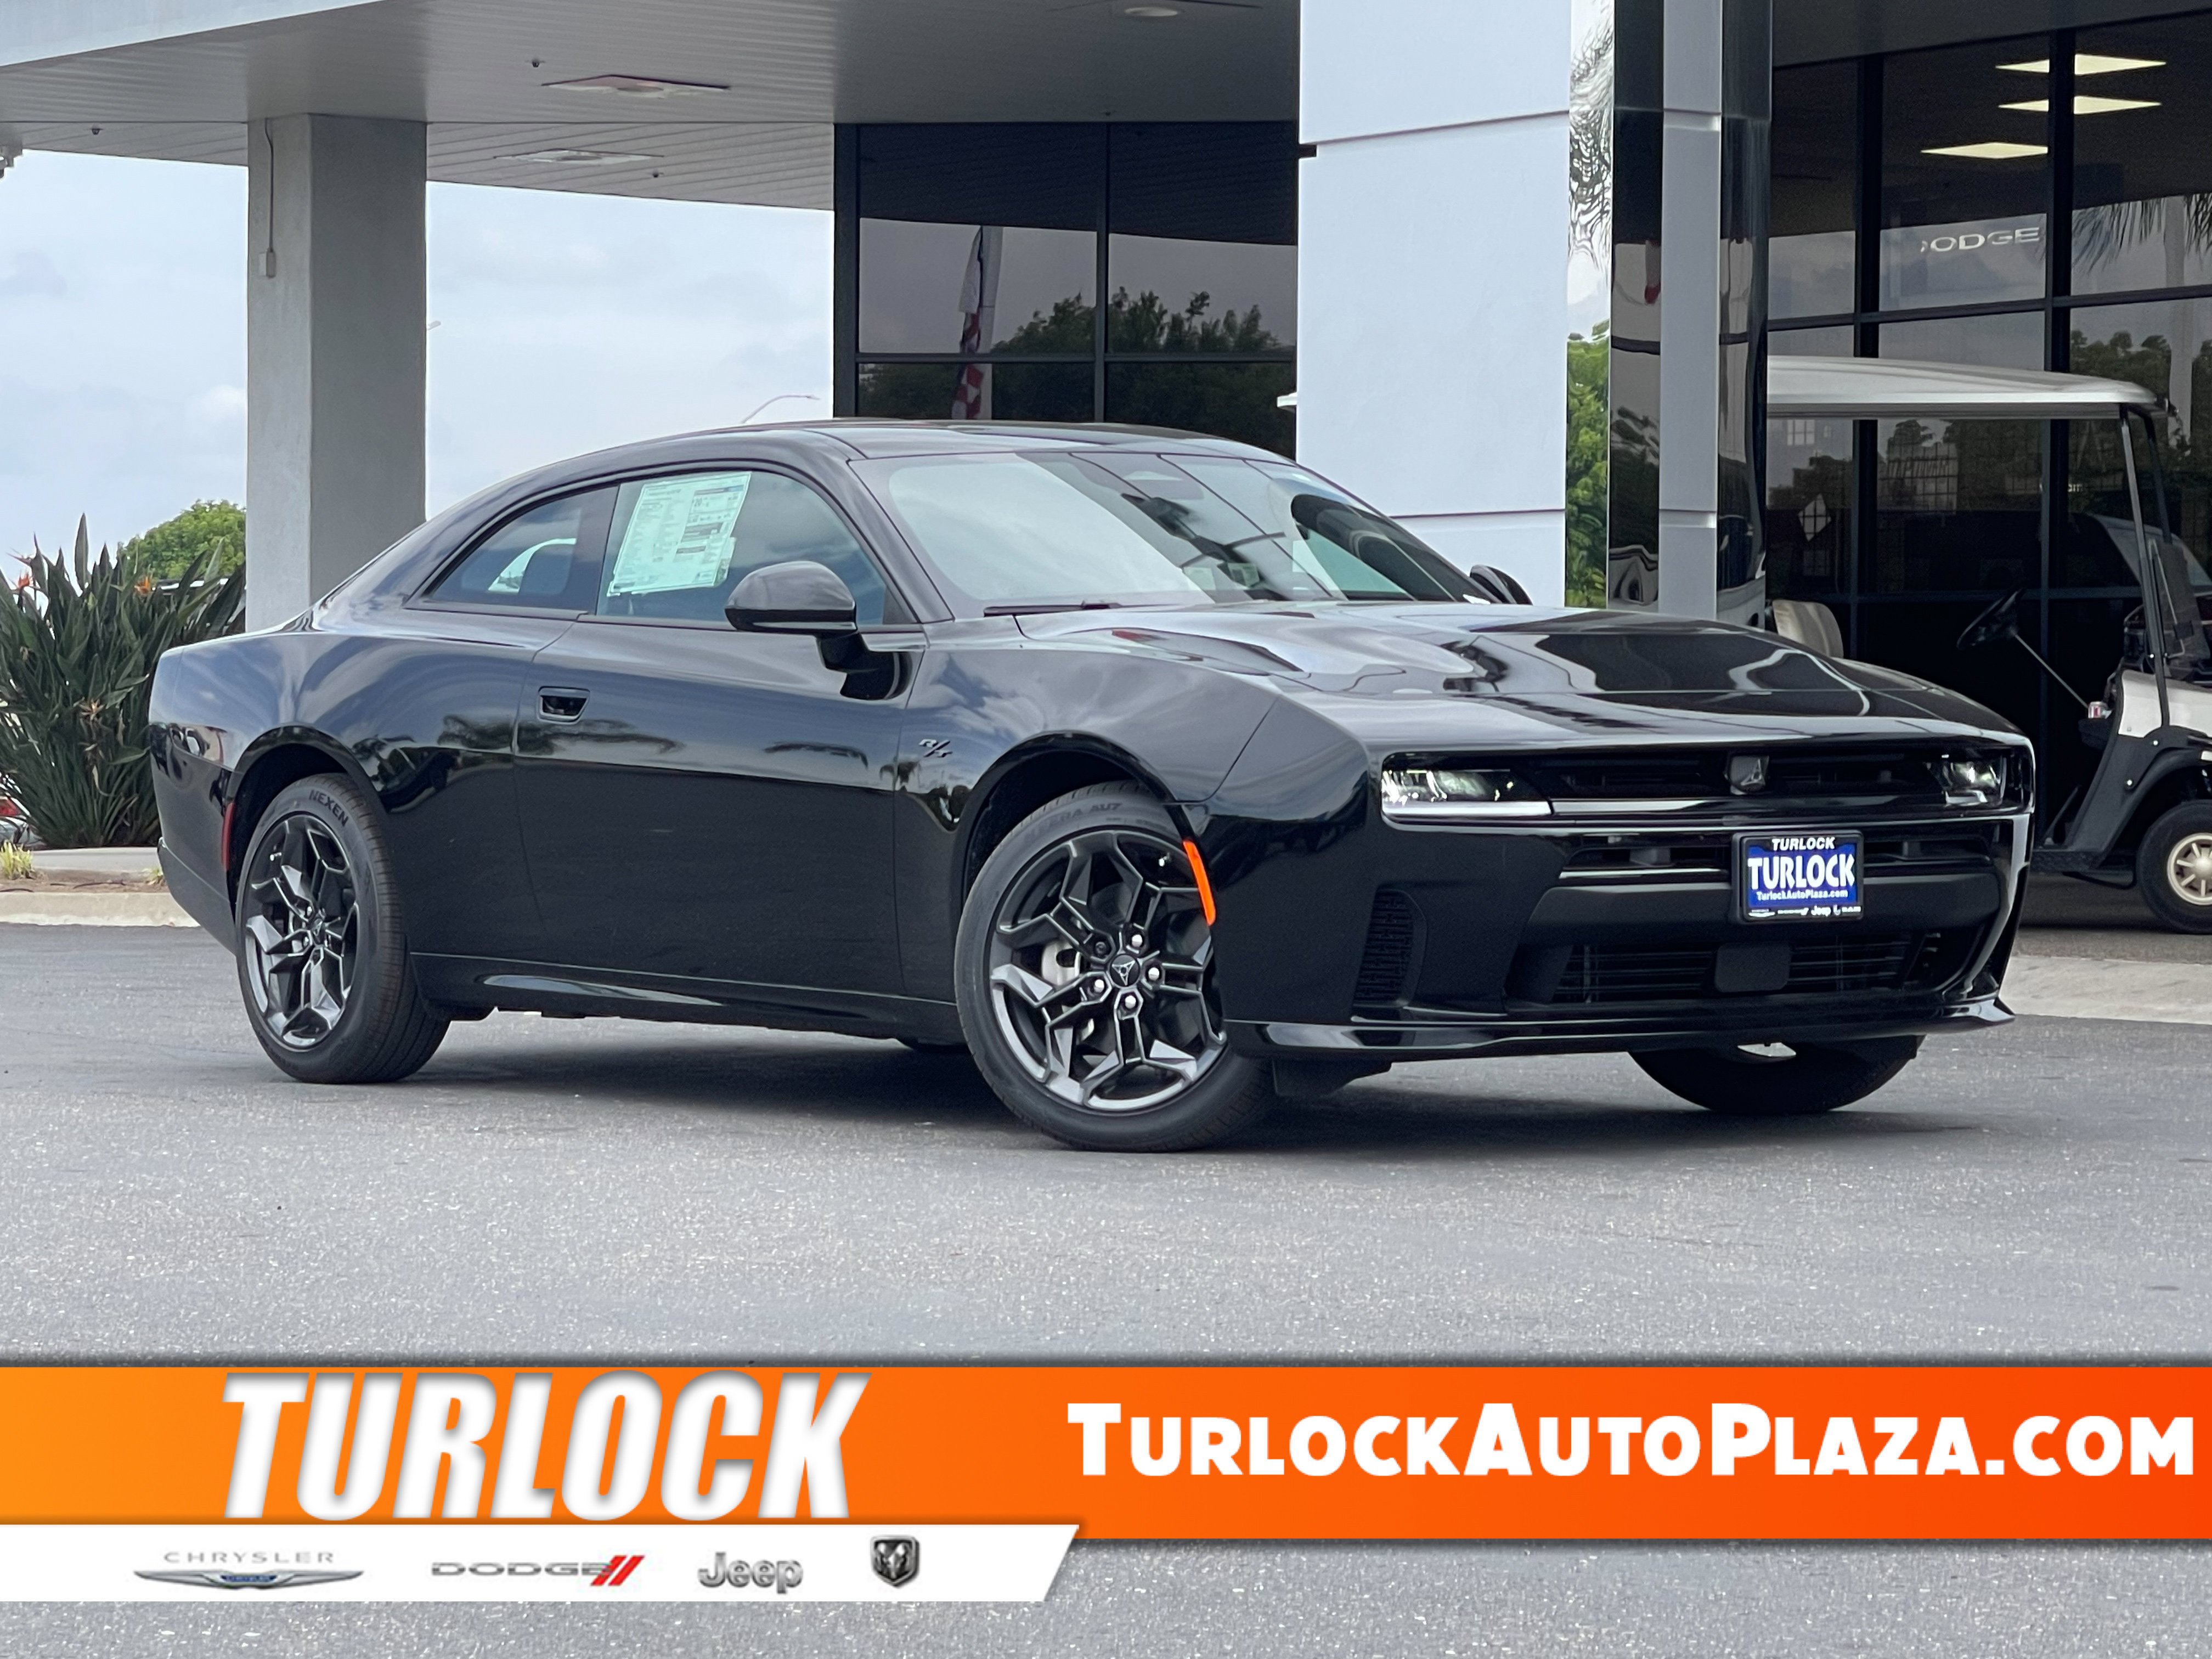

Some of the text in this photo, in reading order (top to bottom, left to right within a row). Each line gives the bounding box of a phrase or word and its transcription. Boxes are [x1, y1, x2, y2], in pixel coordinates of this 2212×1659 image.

[308, 789, 349, 827] NEXEN
[1771, 837, 1835, 851] TURLOCK
[1748, 854, 1855, 890] TURLOCK
[1757, 889, 1848, 901] TurlockAutoPlaza.com
